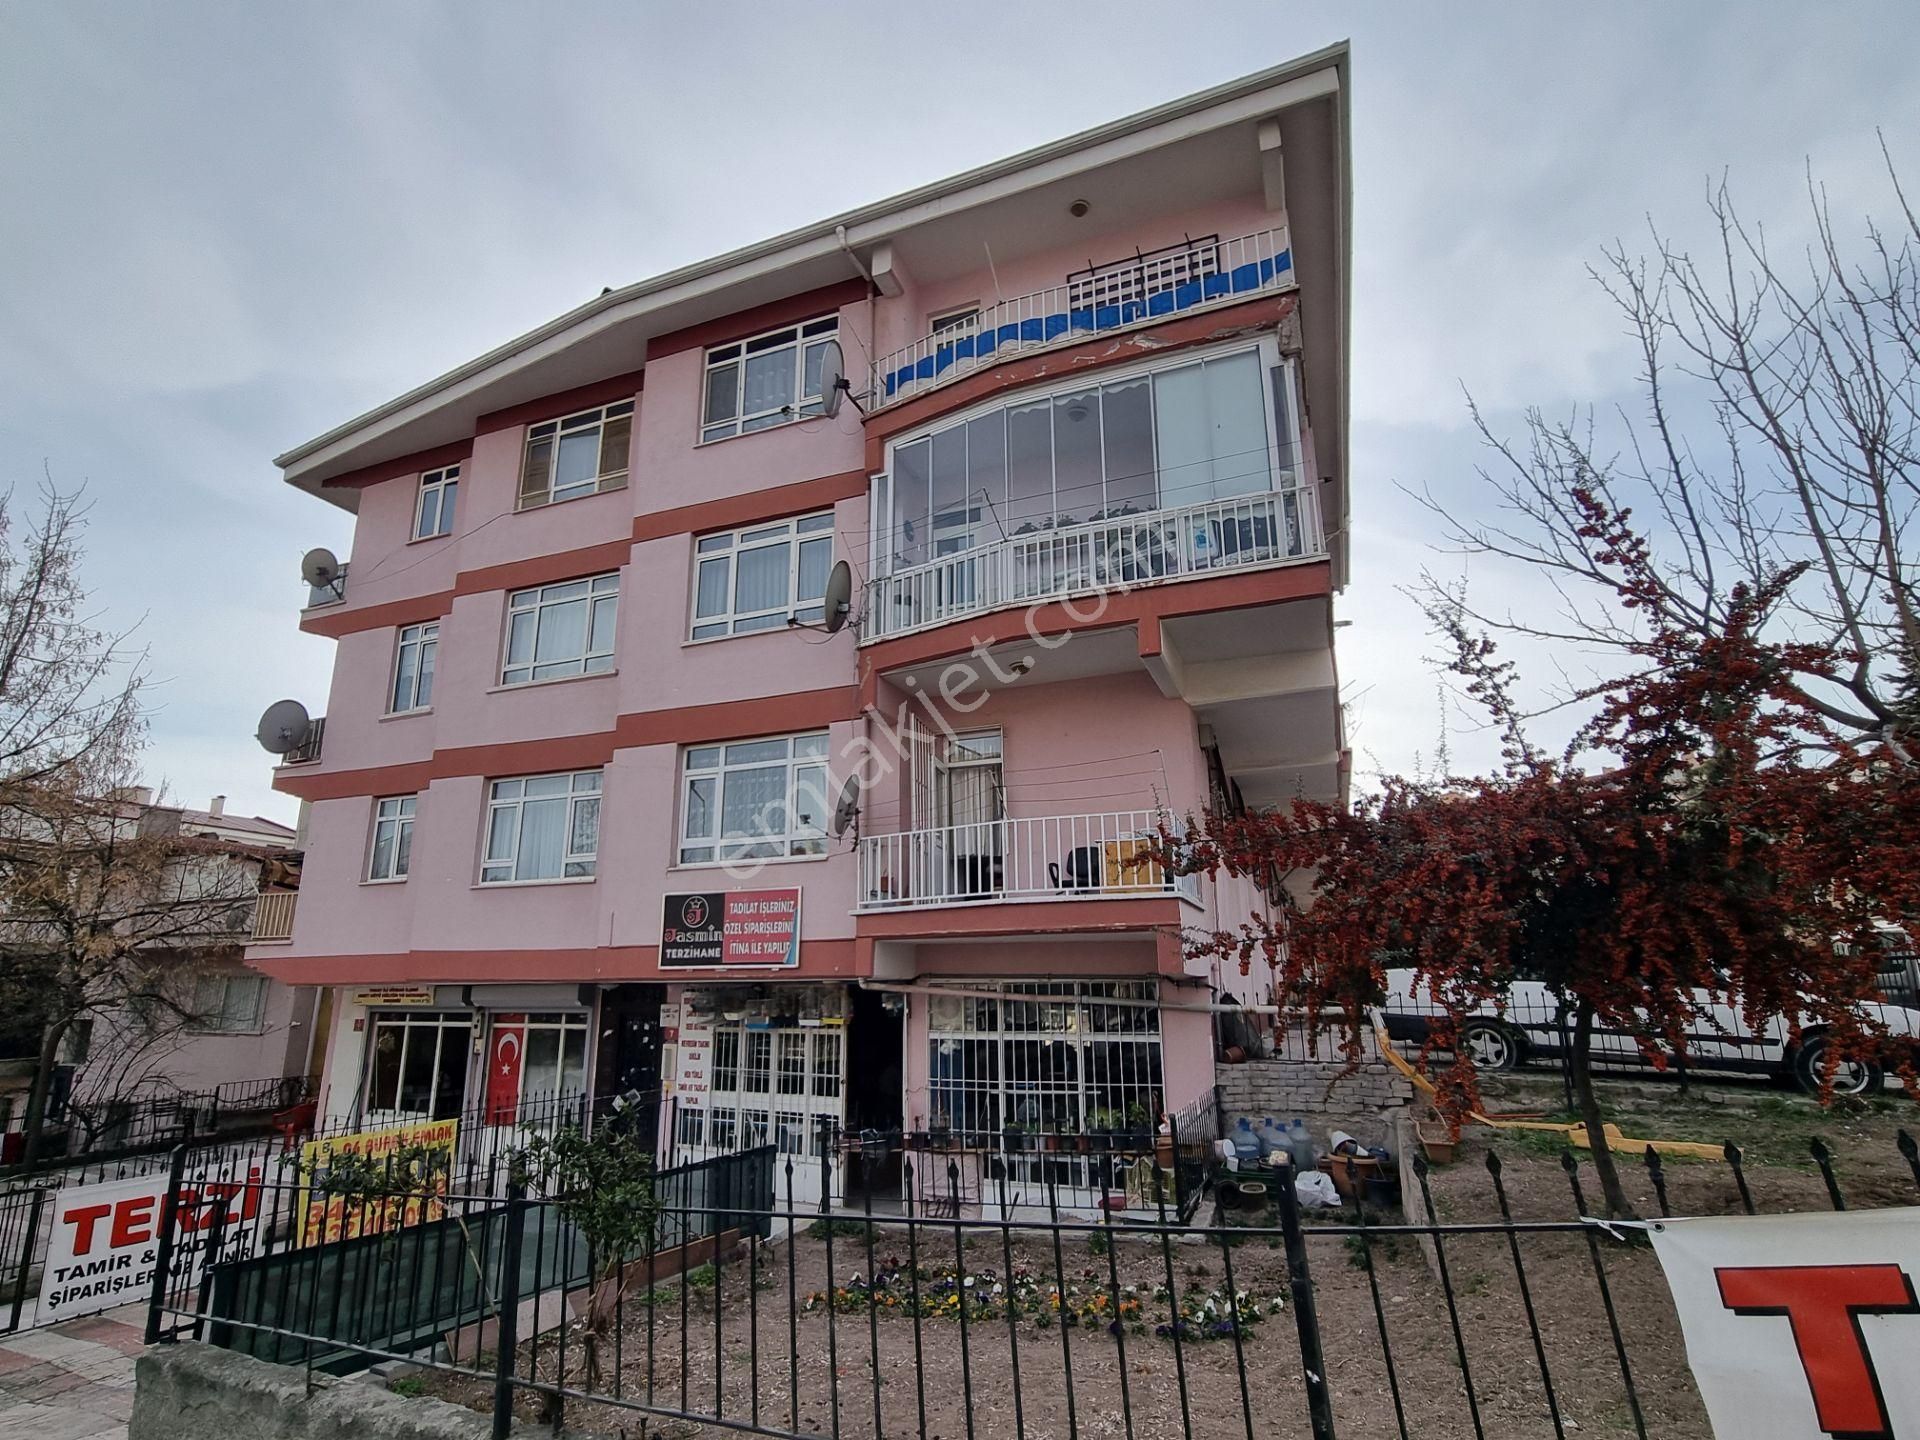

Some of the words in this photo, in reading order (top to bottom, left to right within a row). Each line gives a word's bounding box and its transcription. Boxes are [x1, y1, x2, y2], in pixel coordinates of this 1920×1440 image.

[730, 899, 758, 914] TADİLAT
[760, 898, 795, 917] İŞLERİNİZ
[664, 924, 723, 943] Jasmin
[724, 920, 742, 934] ÖZEL
[666, 946, 721, 959] TERZİHANE
[730, 939, 749, 955] İTİNA
[751, 939, 762, 954] İLE
[413, 1125, 453, 1146] EMLAK
[63, 1167, 260, 1256] TERZİ
[53, 1254, 132, 1283] TAMİR
[140, 1249, 156, 1264] &
[1713, 1263, 1920, 1440] T
